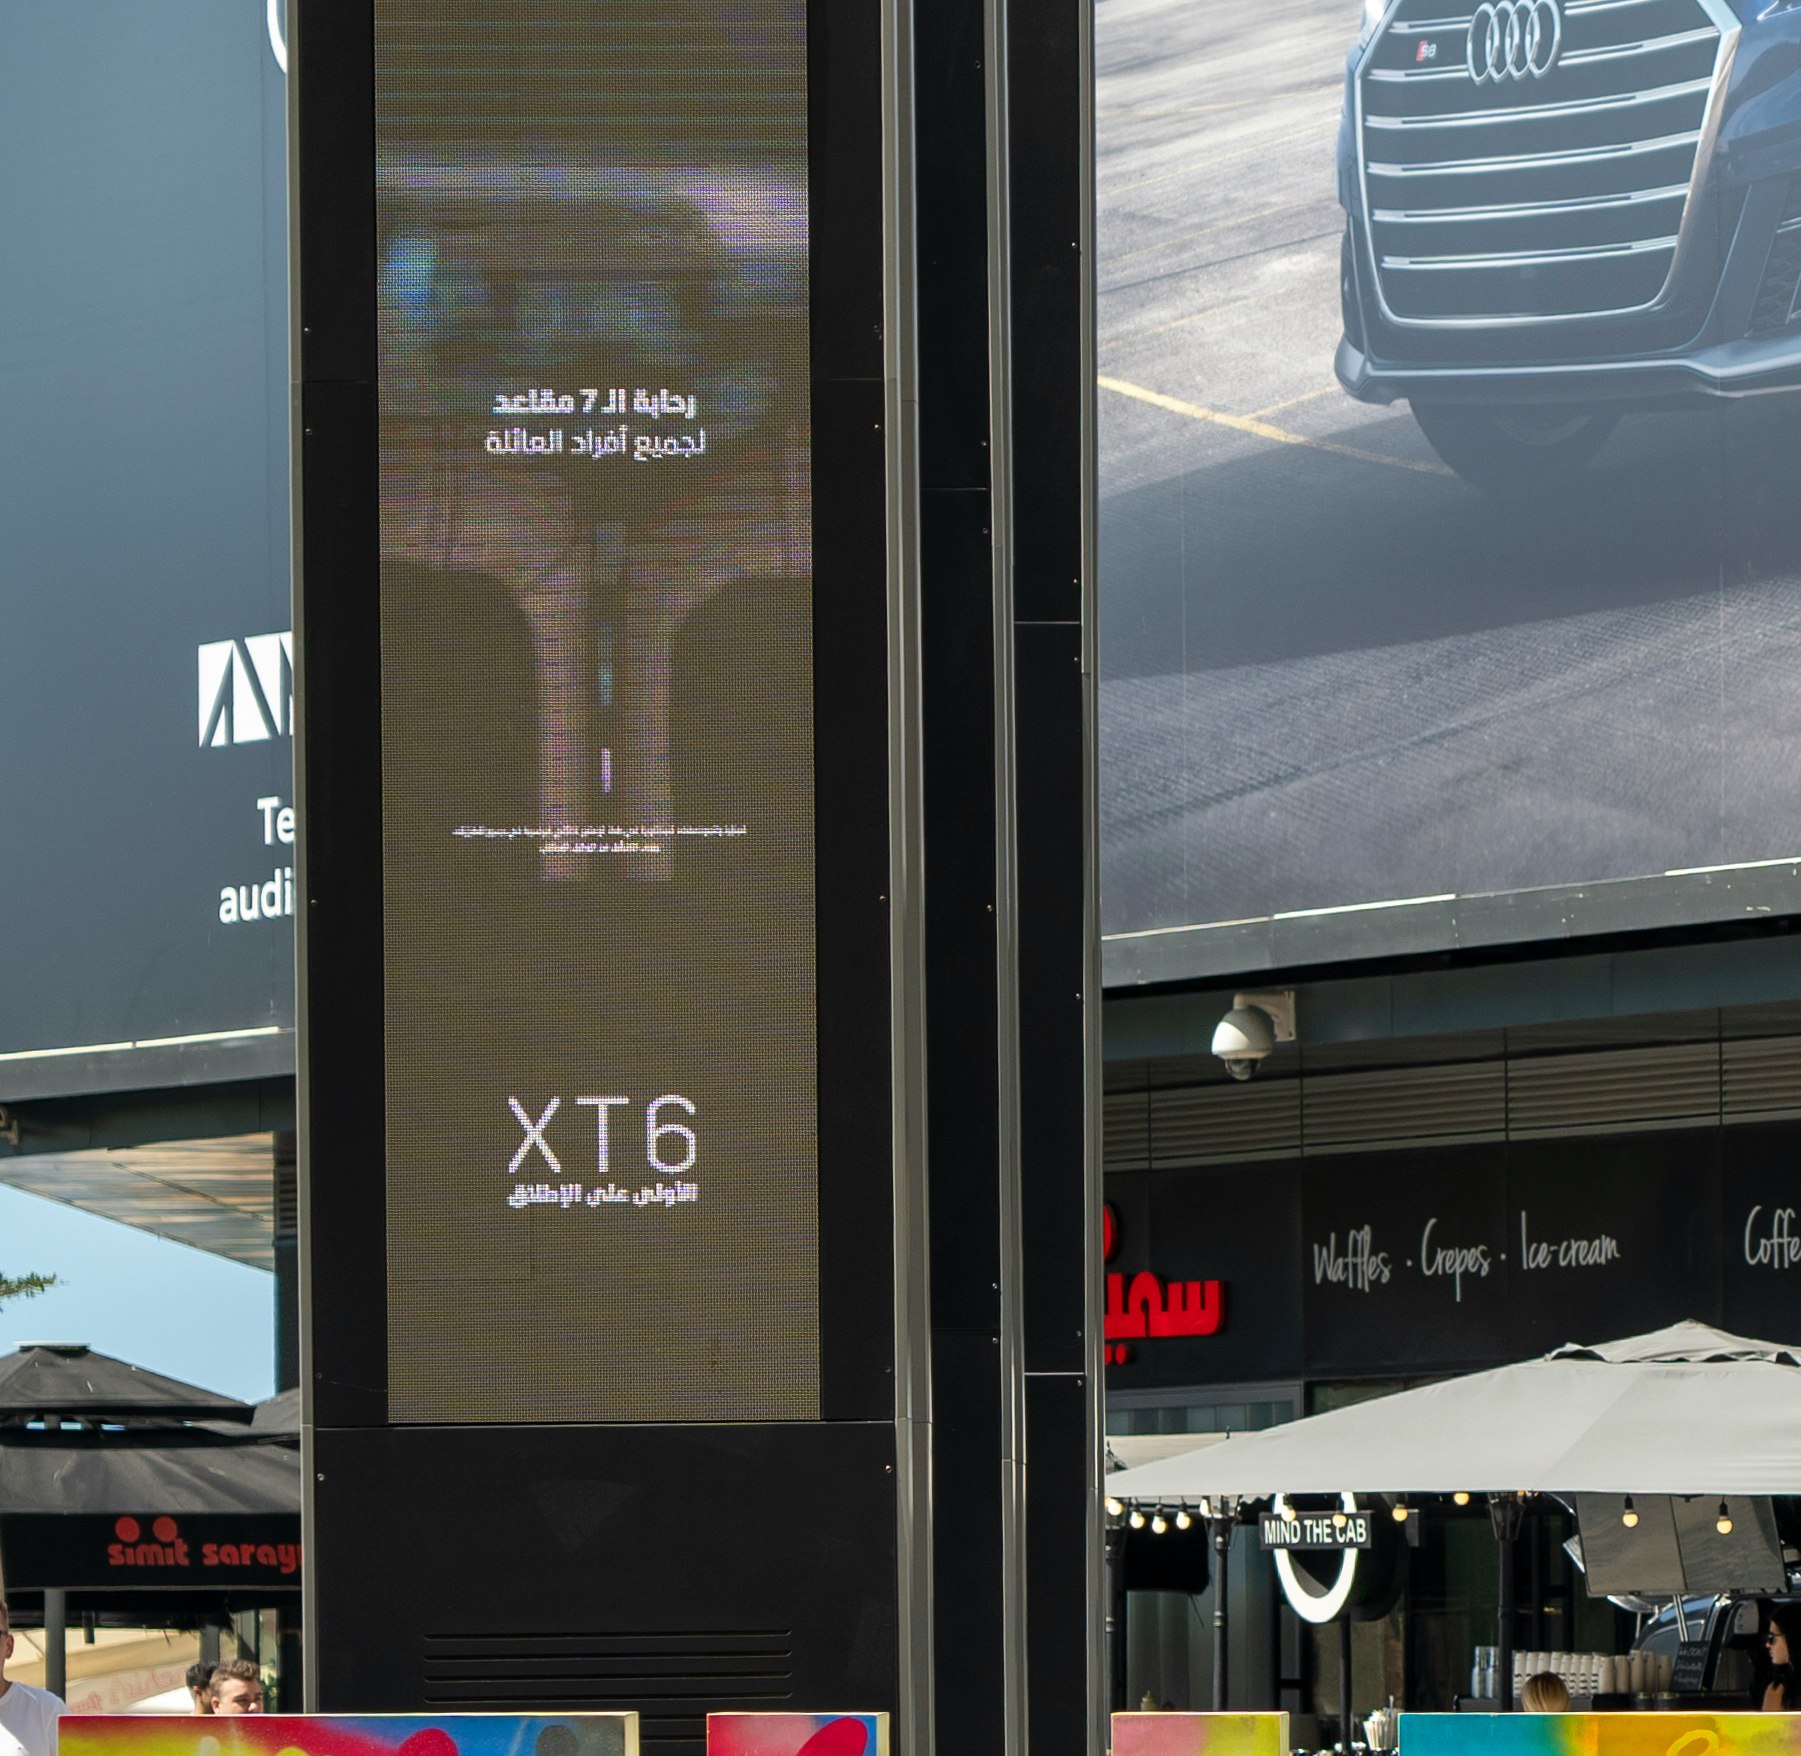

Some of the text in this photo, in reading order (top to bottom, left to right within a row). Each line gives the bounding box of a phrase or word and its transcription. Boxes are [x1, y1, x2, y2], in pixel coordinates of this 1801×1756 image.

[492, 388, 575, 414] مقاعد
[633, 388, 697, 420] رحابة
[485, 423, 706, 462] لجميع أفراد العائلة
[508, 1094, 697, 1174] XT6
[584, 1182, 630, 1208] على
[1313, 1210, 1621, 1302] Waffles Crepes Ice-cream
[1104, 1270, 1220, 1367] سمي
[107, 1516, 190, 1566] simit
[1264, 1518, 1367, 1544] MIND THE CAB
